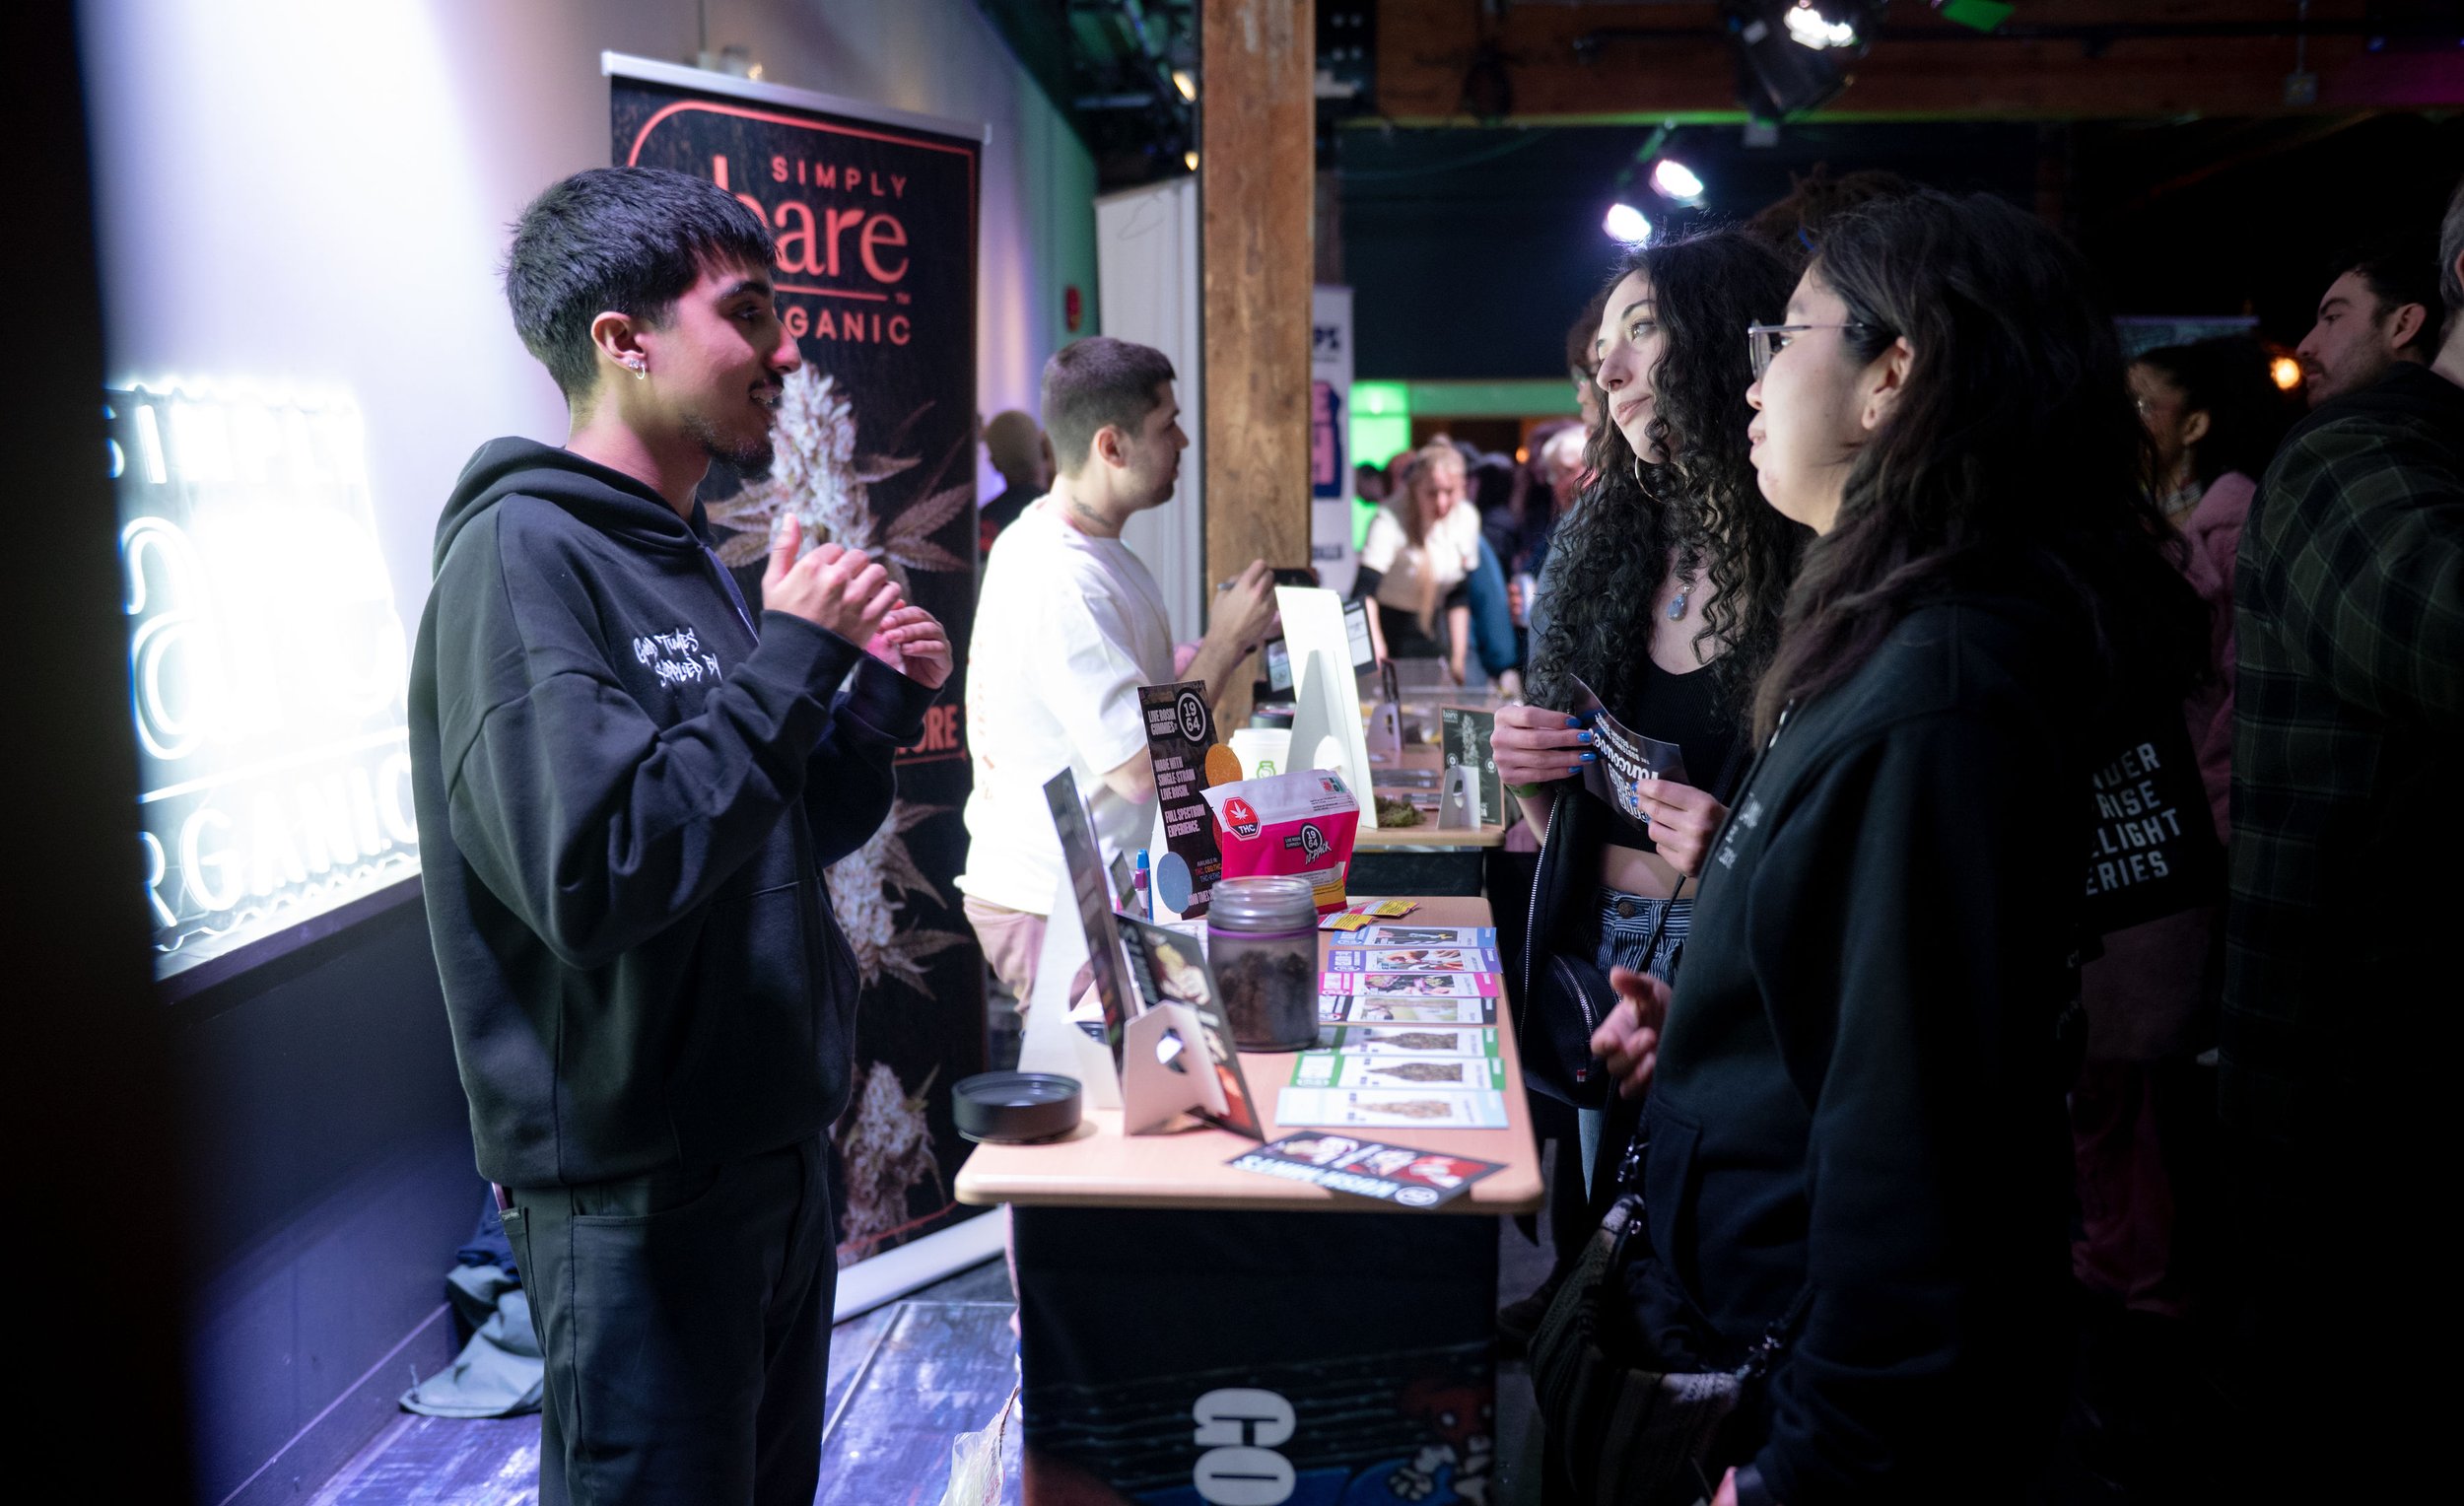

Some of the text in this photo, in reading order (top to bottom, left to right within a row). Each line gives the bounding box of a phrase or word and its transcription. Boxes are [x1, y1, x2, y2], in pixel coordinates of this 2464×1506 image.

[772, 155, 908, 198] SIMPLY
[784, 306, 912, 346] GANIC
[1184, 701, 1198, 718] 19
[1186, 717, 1200, 732] 64
[1589, 728, 1659, 780] ancouve
[1165, 804, 1205, 824] FULL SPECTRUM
[1238, 824, 1256, 835] THC
[1307, 830, 1316, 839] 19
[2091, 808, 2181, 857] LIGHT
[1308, 839, 1318, 848] 64
[1193, 1387, 1296, 1506] GO
